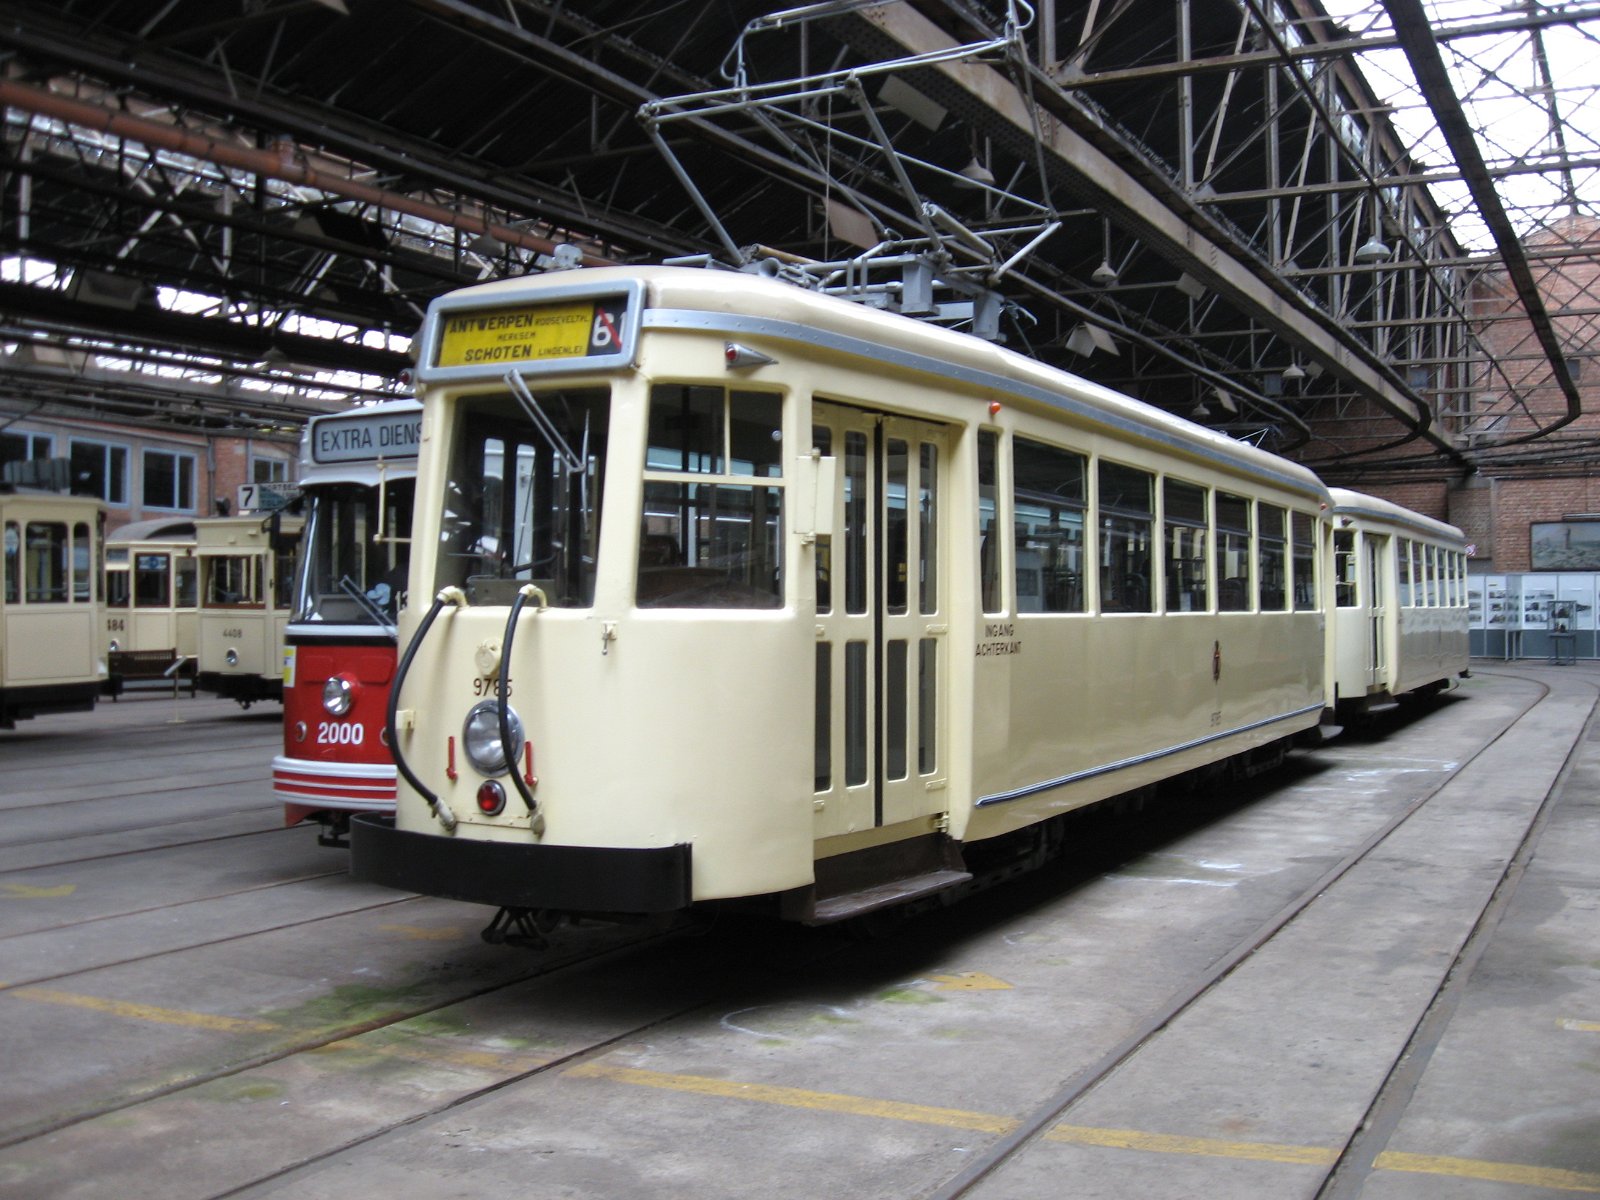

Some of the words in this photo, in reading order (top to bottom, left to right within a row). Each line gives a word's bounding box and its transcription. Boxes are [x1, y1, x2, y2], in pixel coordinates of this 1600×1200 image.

[449, 313, 534, 334] ANTWERPEN
[592, 312, 627, 347] 61
[465, 345, 532, 362] SCHOTEN
[321, 427, 373, 452] EXTRA
[242, 486, 254, 507] 7
[985, 624, 1014, 638] INGANG
[975, 641, 1022, 657] ACHTERKANT
[317, 721, 364, 745] 2000
